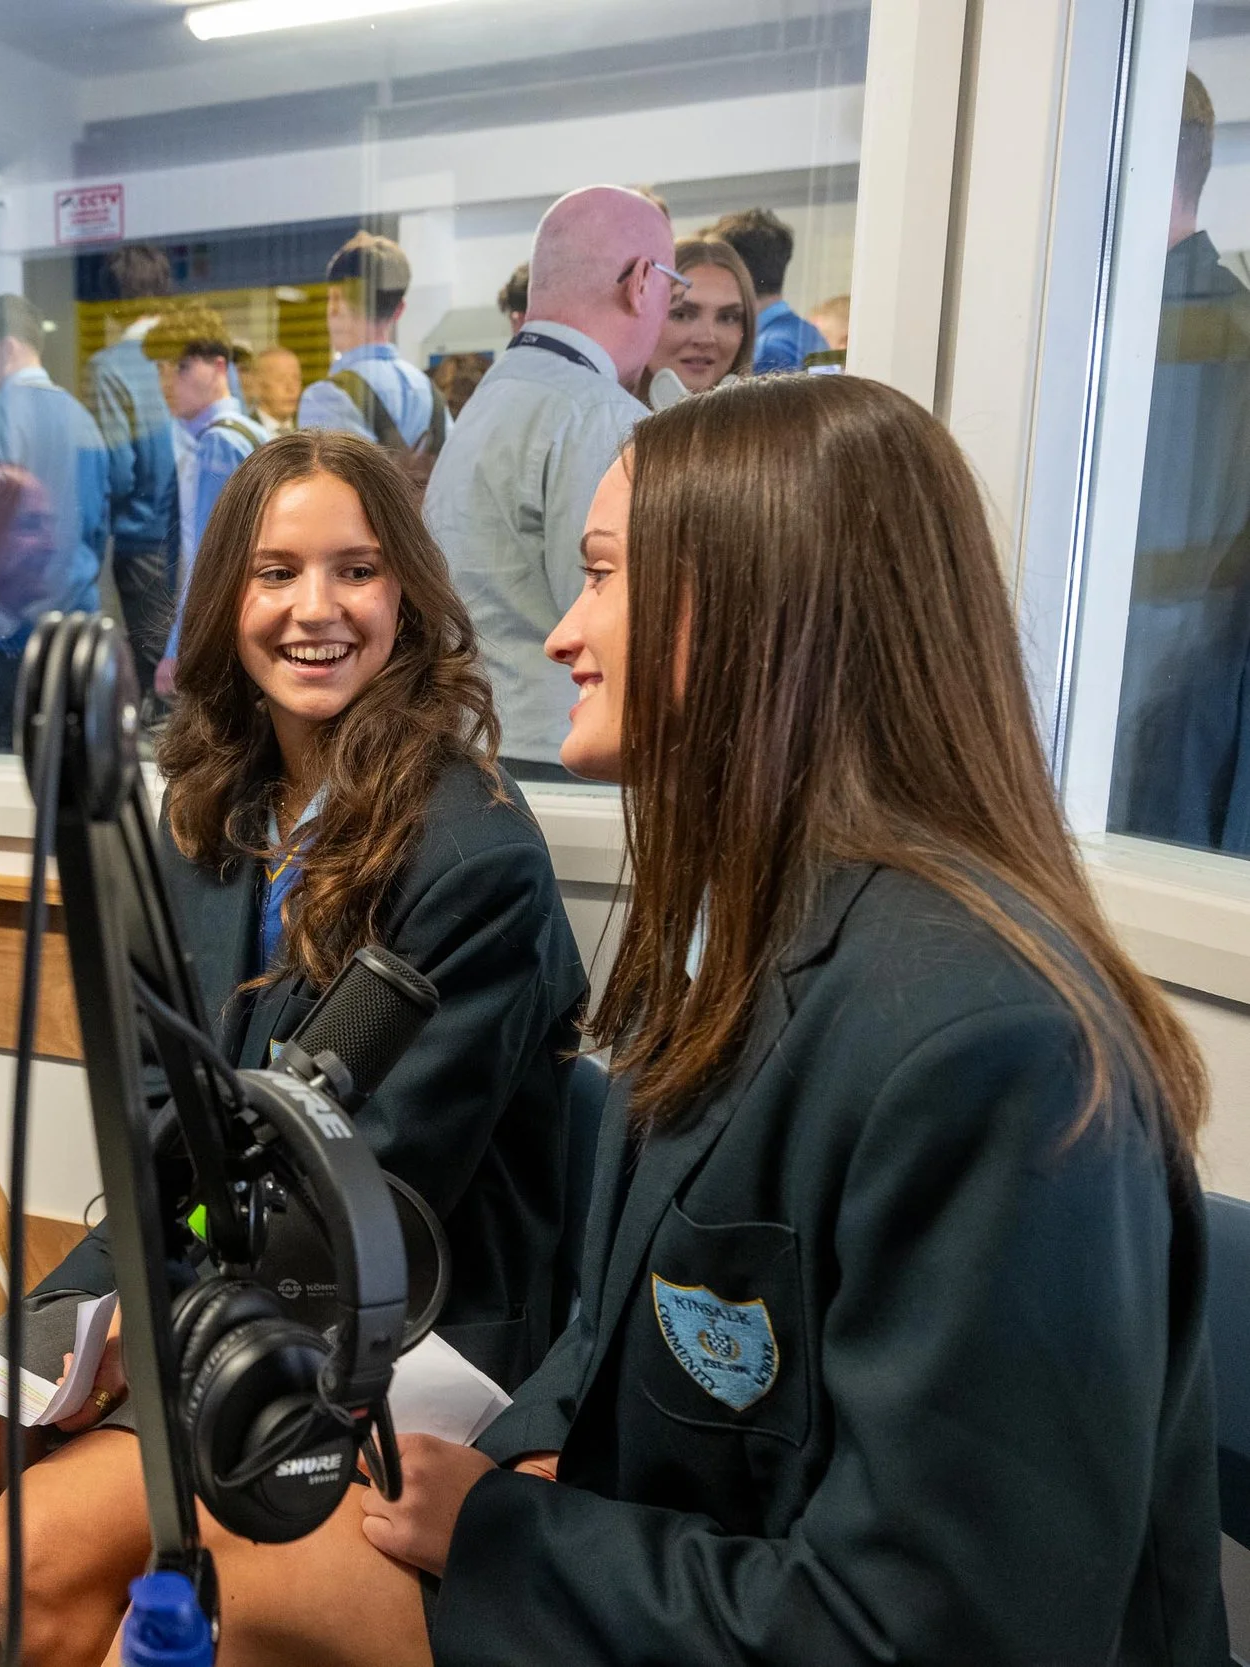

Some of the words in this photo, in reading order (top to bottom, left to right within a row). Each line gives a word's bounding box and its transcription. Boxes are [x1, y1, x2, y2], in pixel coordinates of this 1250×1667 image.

[673, 1295, 751, 1326] KINSALE
[657, 1303, 721, 1390] COMMUNITY
[275, 1453, 343, 1477] SHURE
